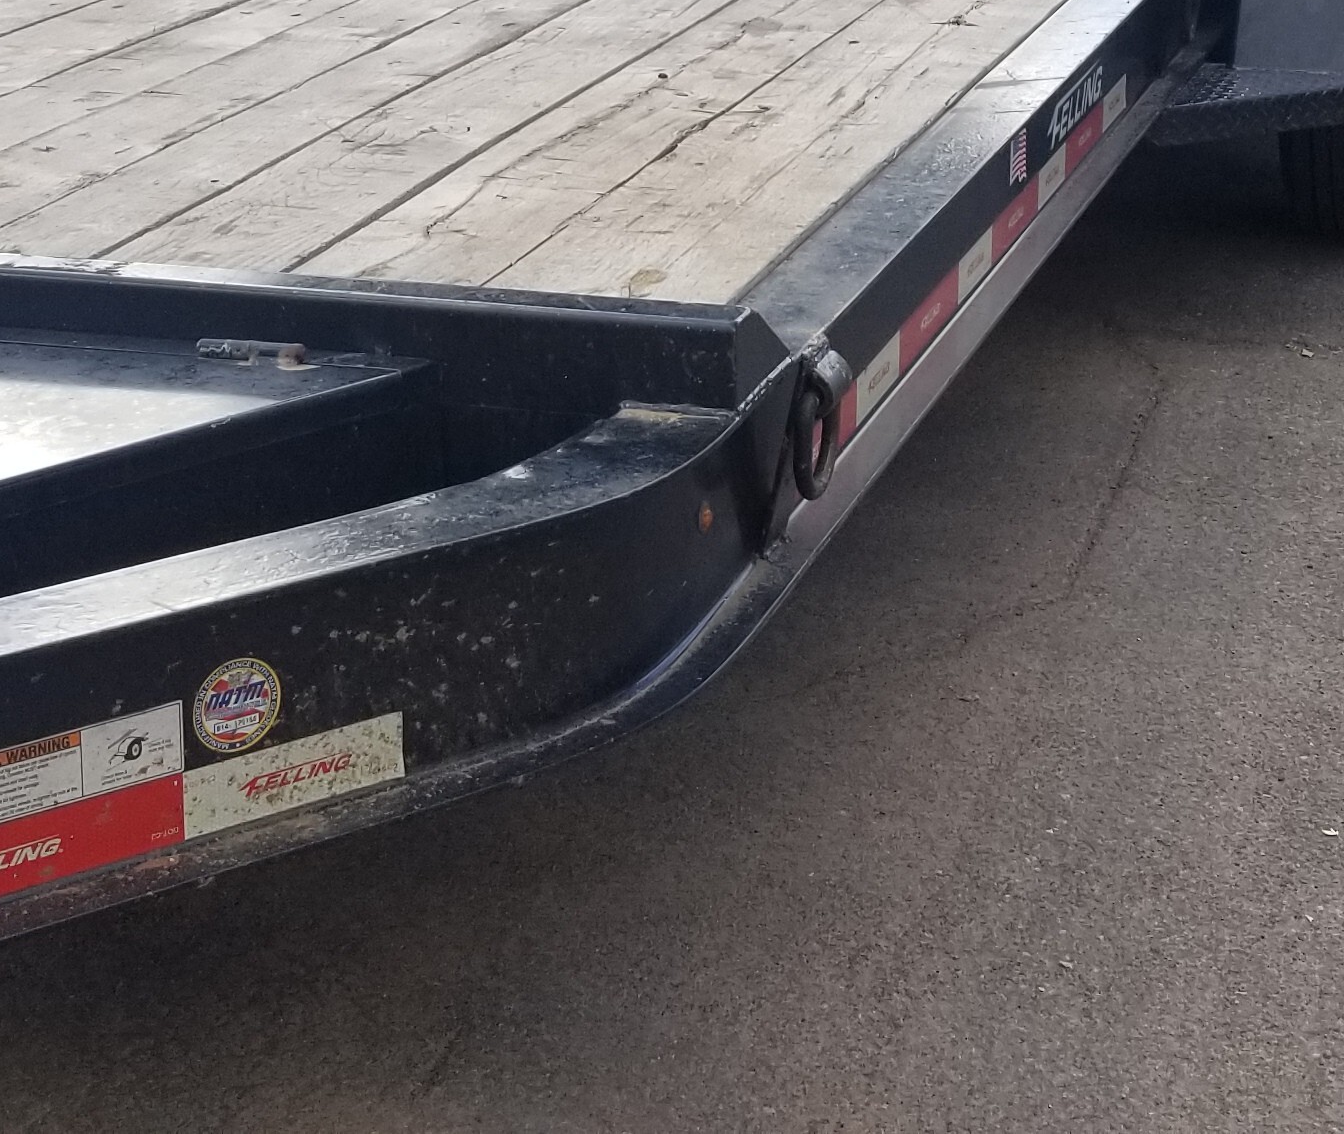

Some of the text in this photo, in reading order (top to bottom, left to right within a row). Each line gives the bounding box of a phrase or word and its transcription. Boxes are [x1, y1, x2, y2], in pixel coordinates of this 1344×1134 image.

[1047, 59, 1103, 150] FELLING
[6, 736, 71, 765] WARNING
[240, 753, 353, 797] FELLING
